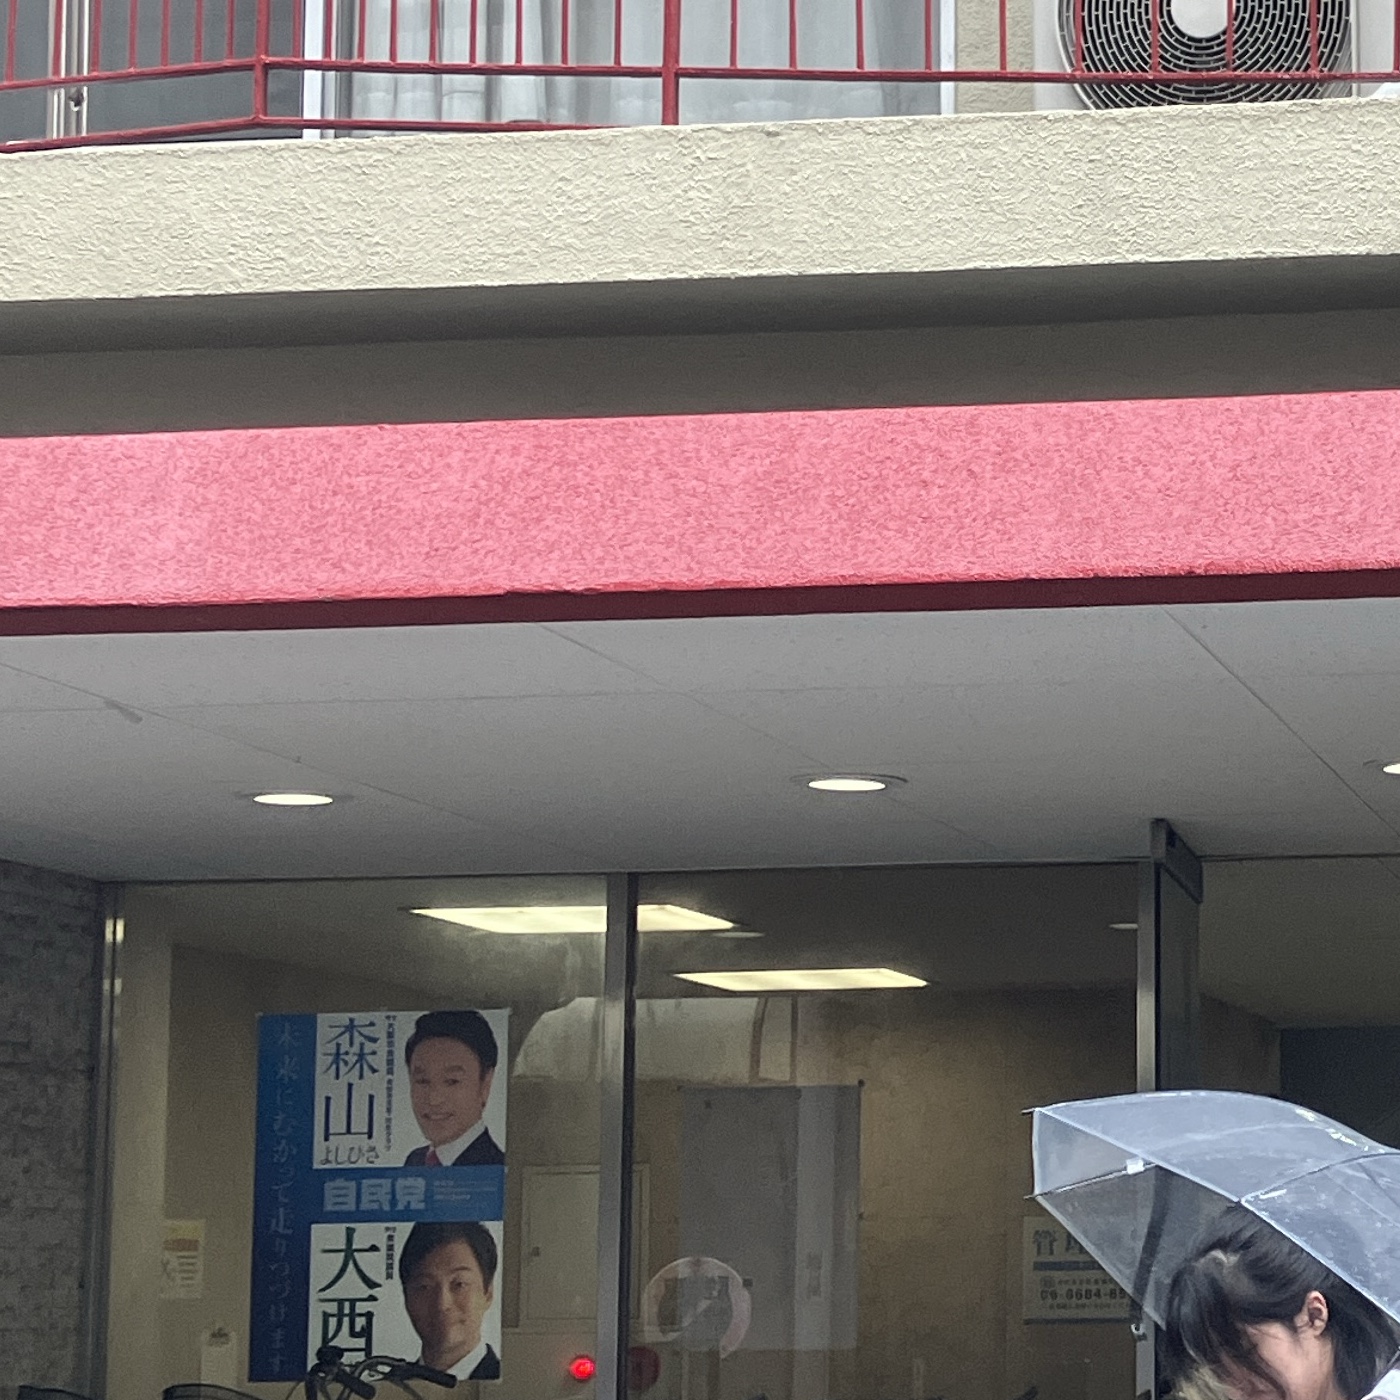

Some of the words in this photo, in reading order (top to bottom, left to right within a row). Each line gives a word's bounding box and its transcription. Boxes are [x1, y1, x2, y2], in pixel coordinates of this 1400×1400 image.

[320, 1016, 381, 1142] 森山
[319, 1144, 380, 1166] よしひさ
[322, 1177, 428, 1212] 自民党
[315, 1225, 383, 1358] 大西
